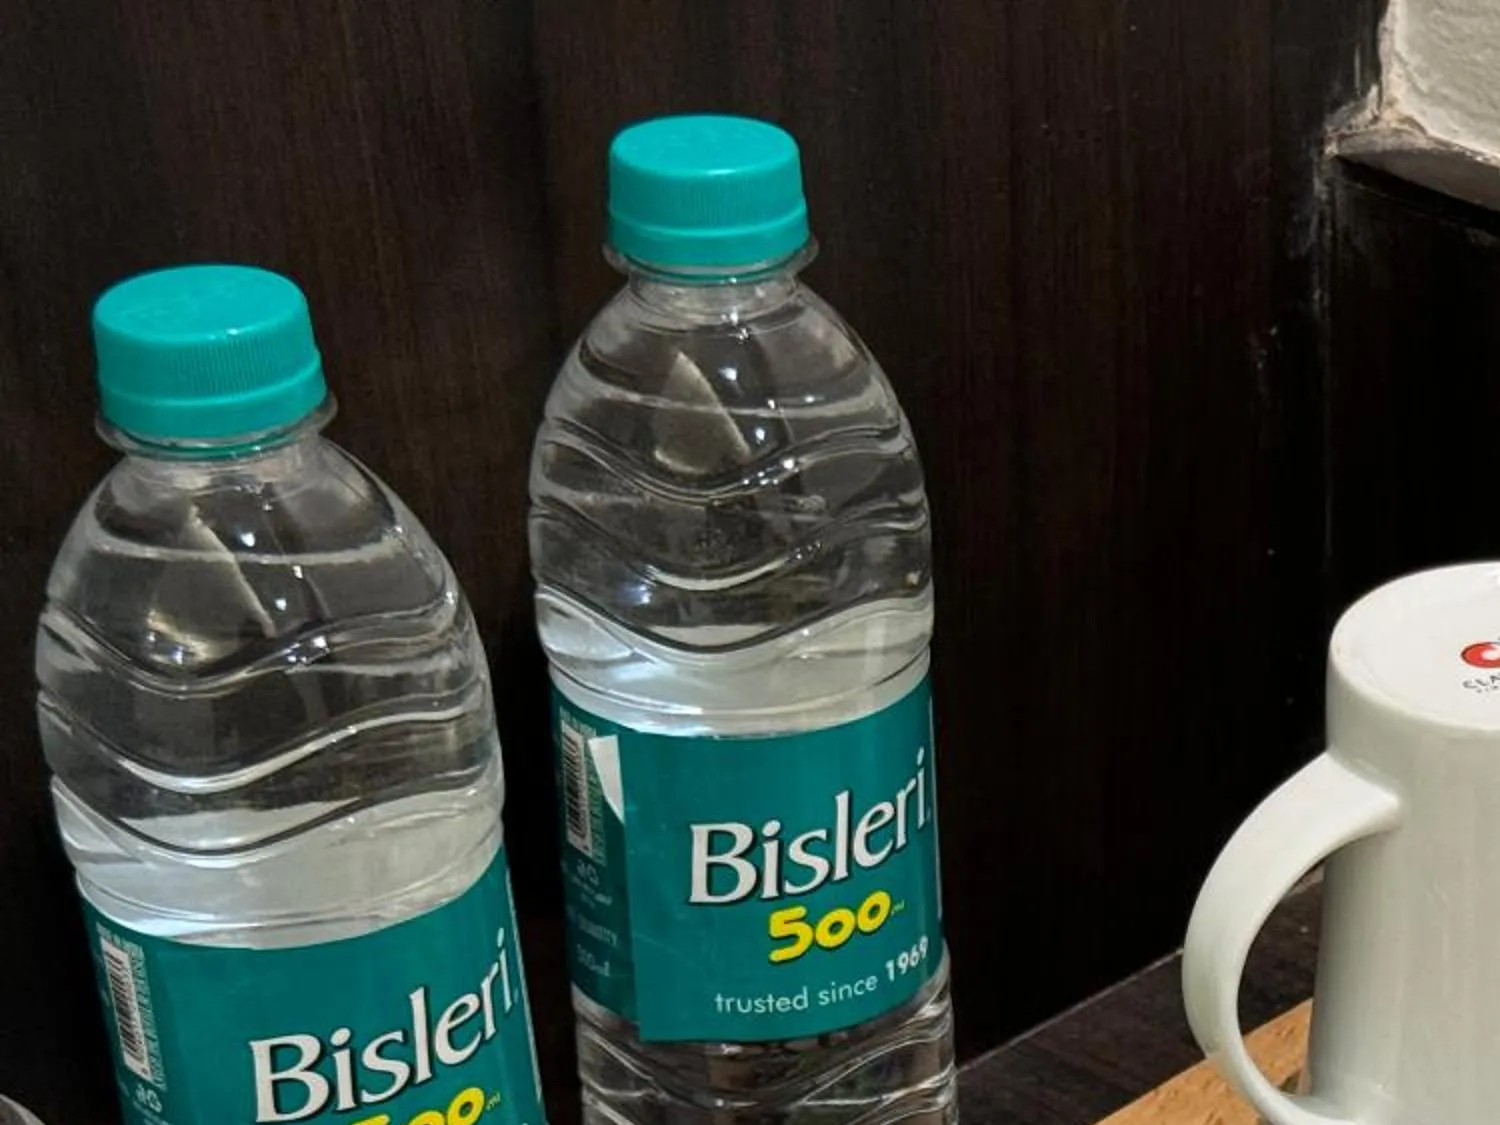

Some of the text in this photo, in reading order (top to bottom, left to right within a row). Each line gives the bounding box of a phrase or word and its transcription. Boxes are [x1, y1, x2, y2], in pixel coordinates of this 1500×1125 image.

[688, 747, 927, 904] Bisleri
[715, 935, 930, 1015] trusted since 1969
[768, 890, 892, 963] 500
[249, 927, 514, 1124] Bisleri
